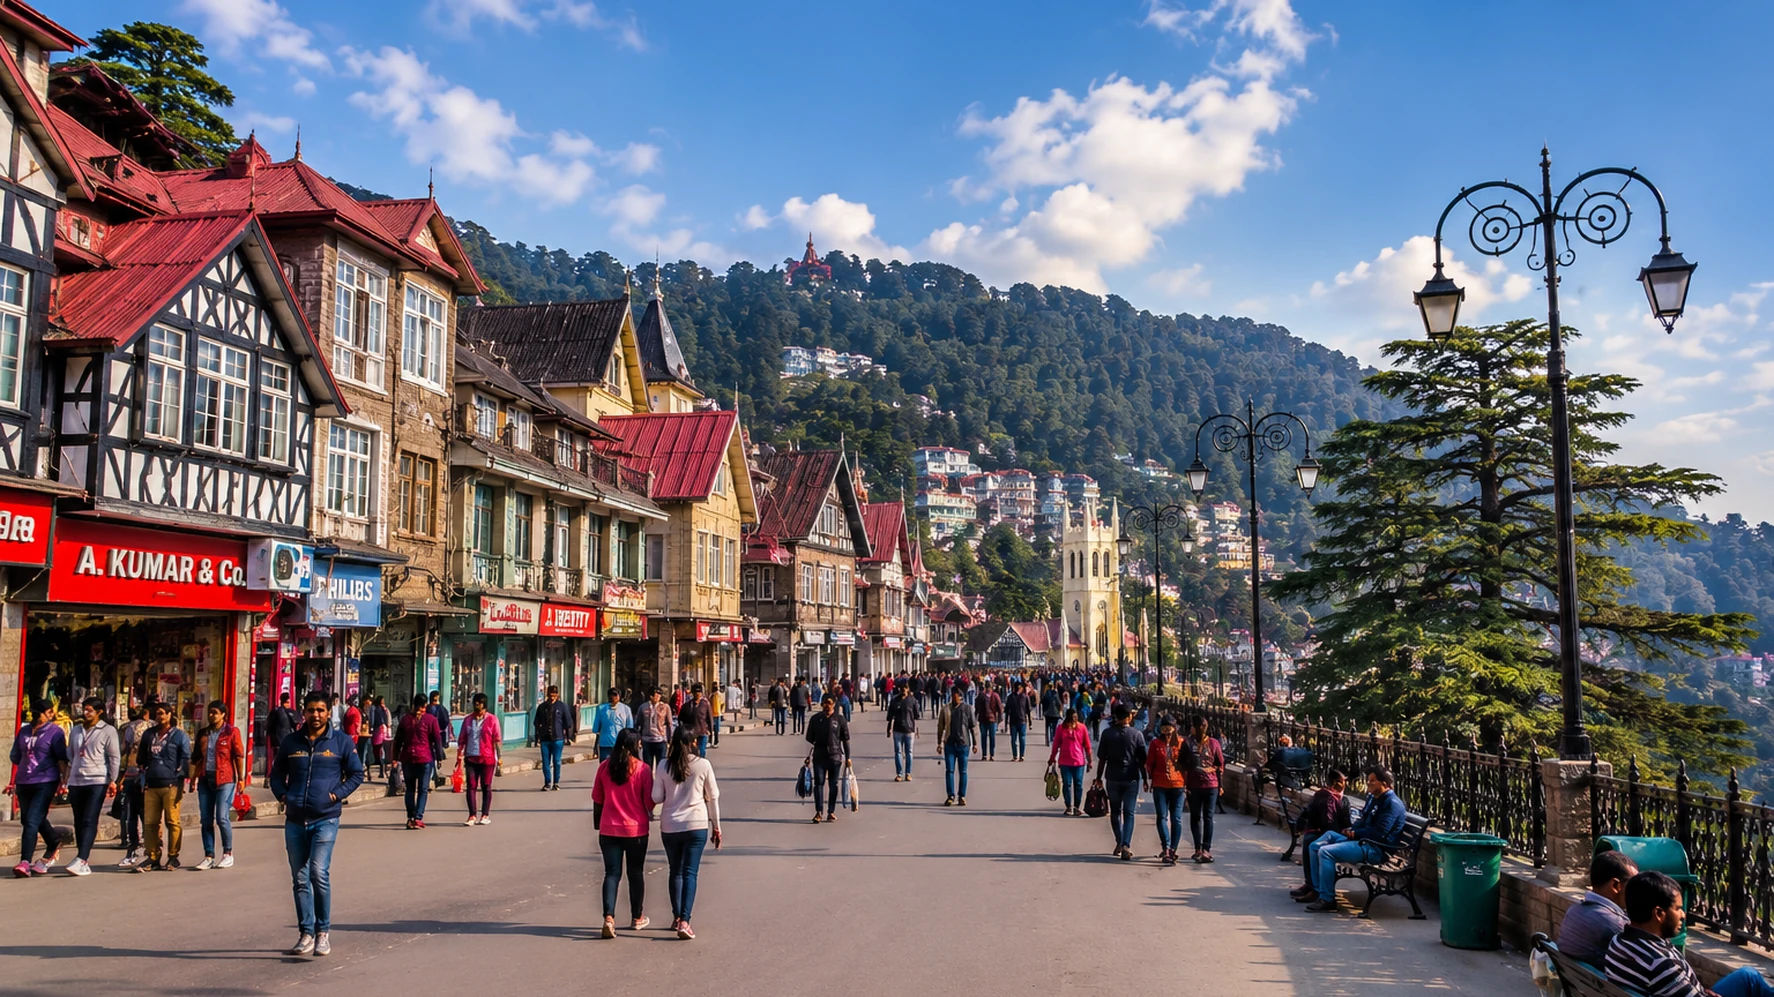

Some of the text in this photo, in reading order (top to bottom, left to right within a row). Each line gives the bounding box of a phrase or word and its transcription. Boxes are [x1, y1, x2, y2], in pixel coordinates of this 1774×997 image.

[76, 545, 247, 586] A. KUMAR & Co.
